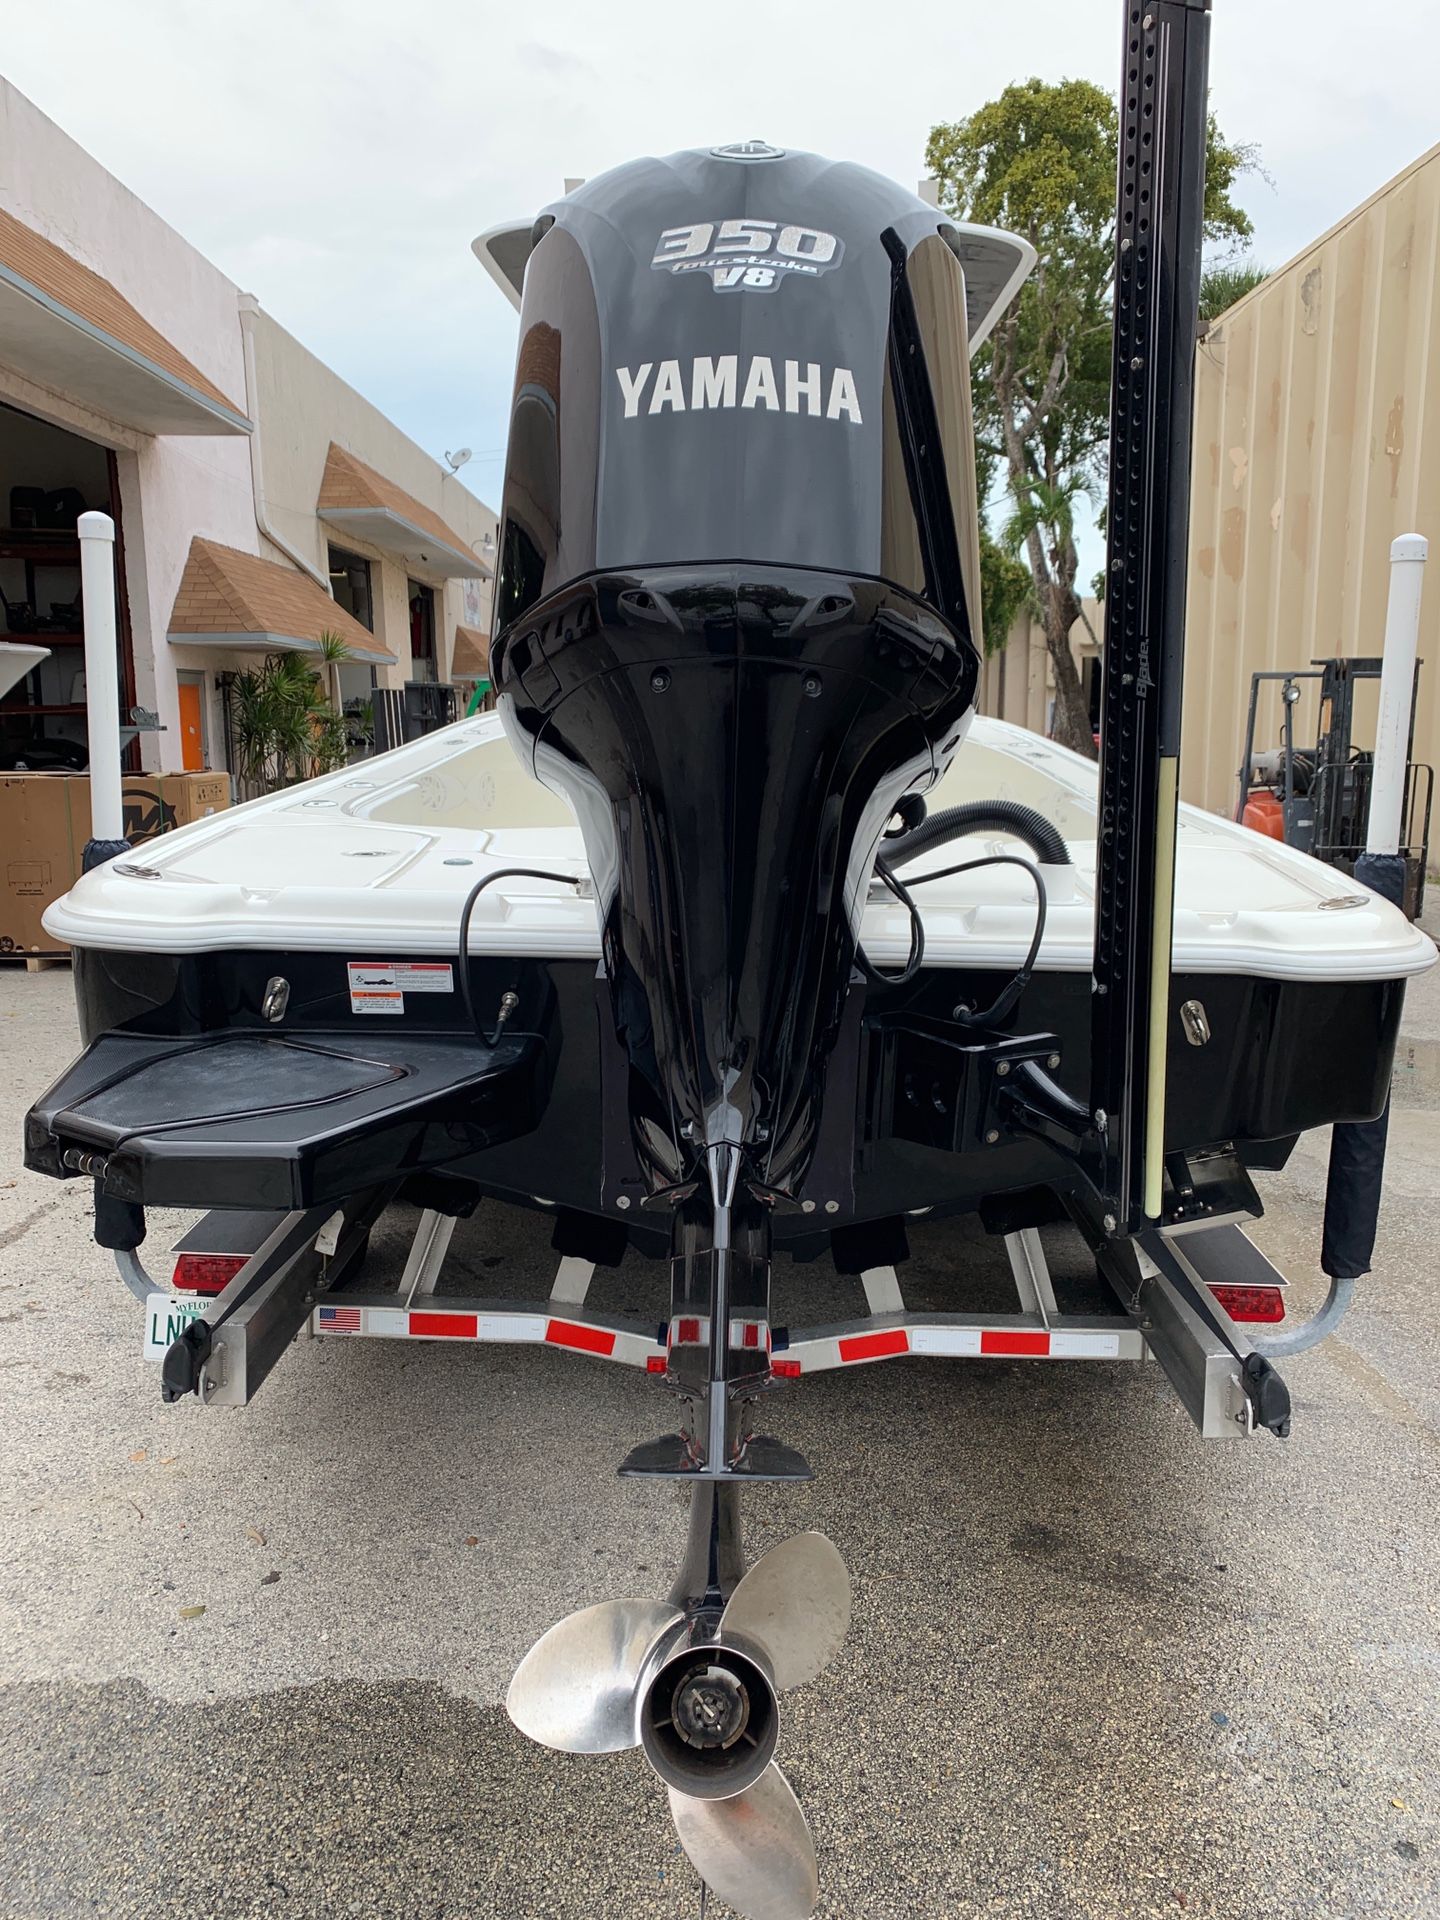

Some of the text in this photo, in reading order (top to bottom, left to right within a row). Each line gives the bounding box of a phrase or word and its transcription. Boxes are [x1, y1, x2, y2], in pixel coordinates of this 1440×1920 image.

[652, 219, 837, 262] 350
[713, 266, 775, 287] V8
[615, 355, 863, 424] YAMAHA
